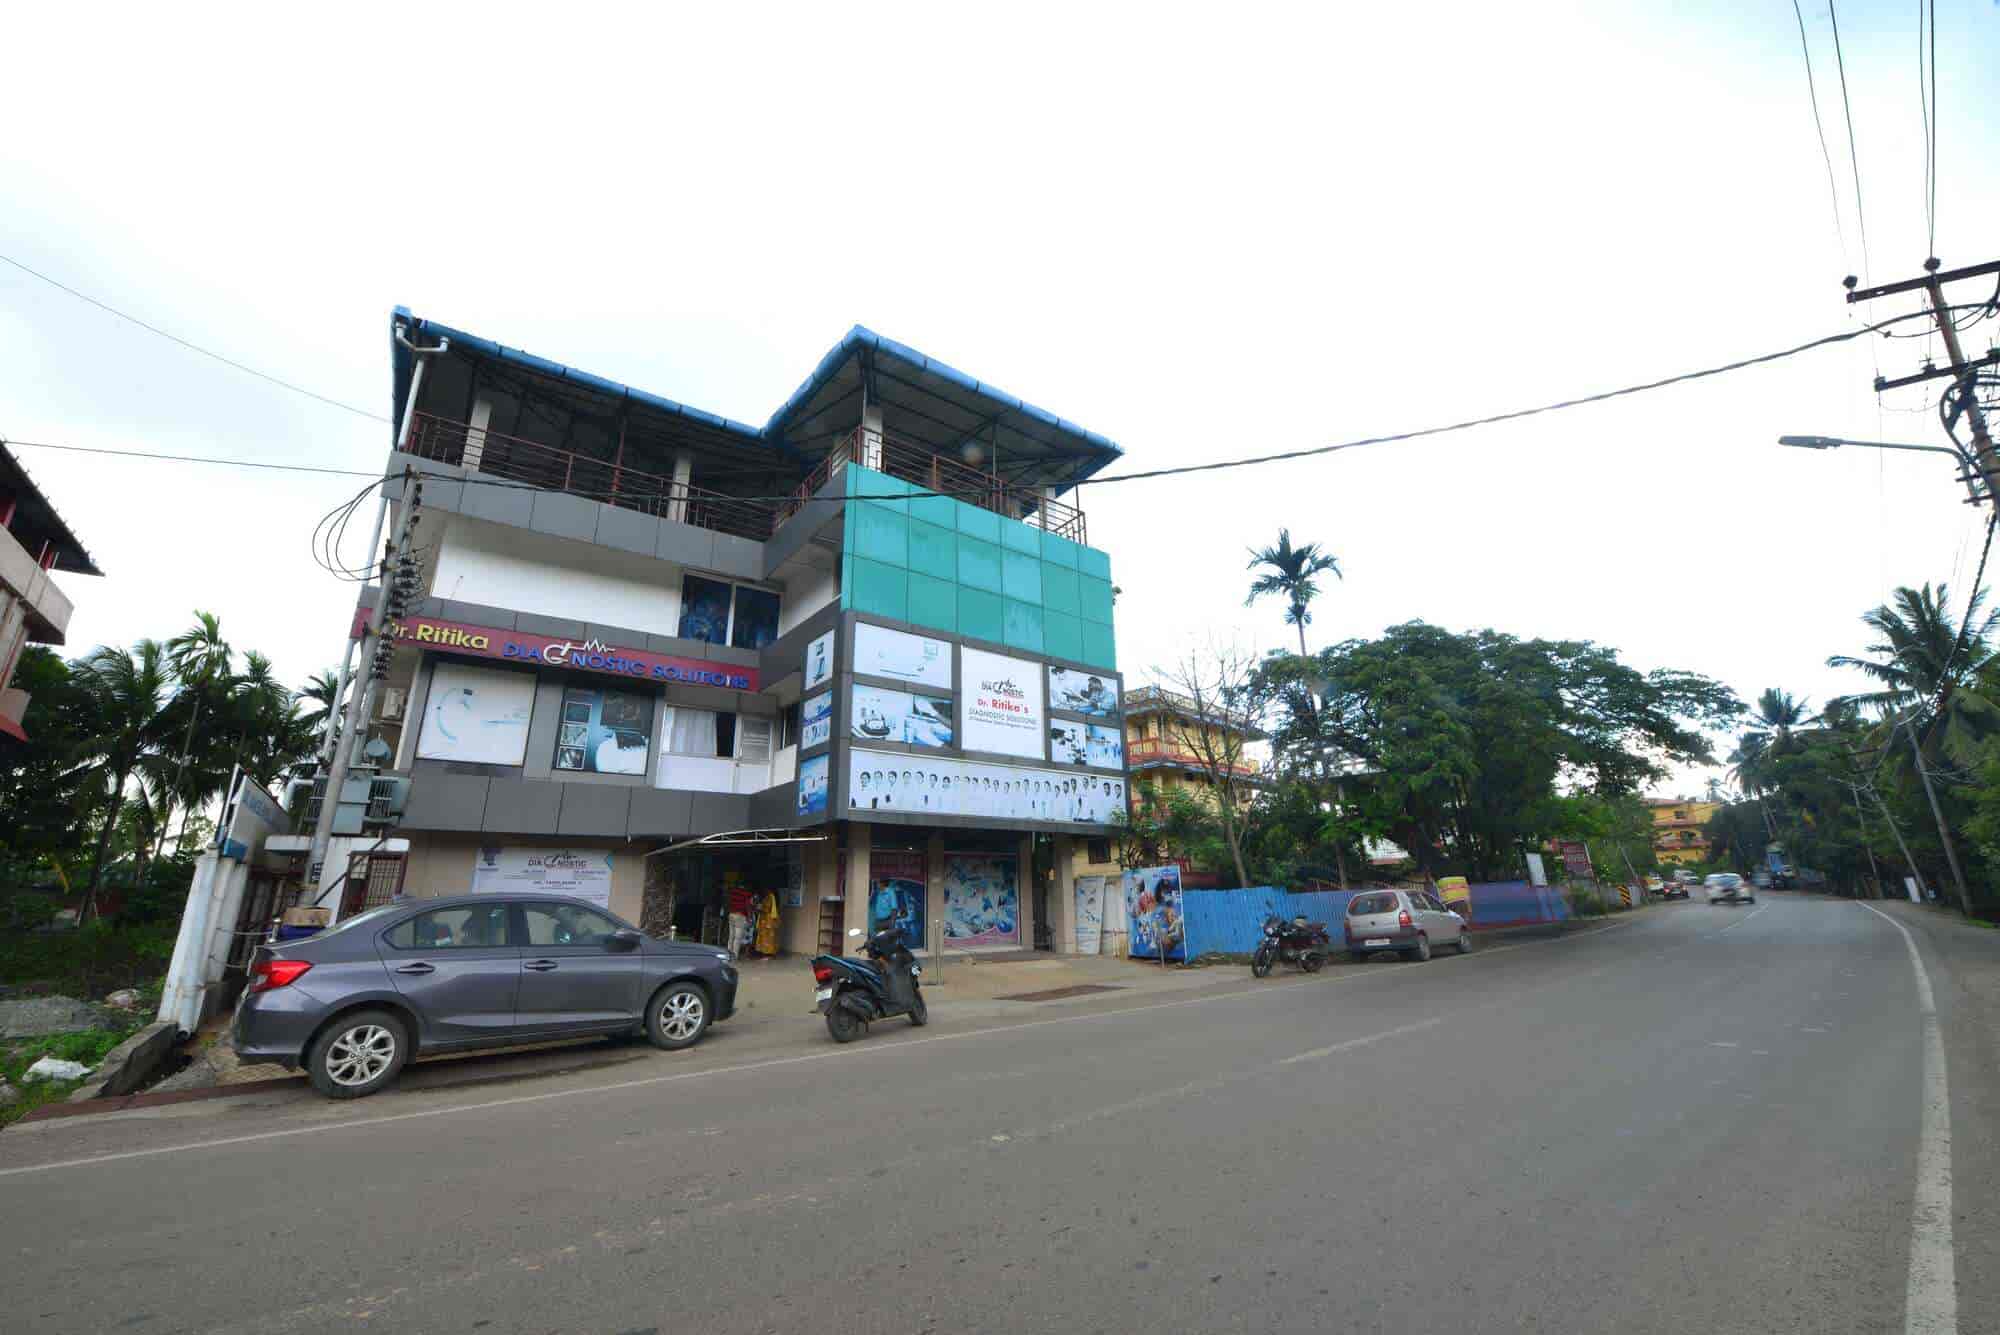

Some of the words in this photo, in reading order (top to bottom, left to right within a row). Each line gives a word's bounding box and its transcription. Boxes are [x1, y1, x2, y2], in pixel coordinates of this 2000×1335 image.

[416, 623, 489, 650] Ritika
[503, 639, 646, 675] DIAGNOSTIC
[652, 664, 749, 690] SOLUTIONS
[977, 698, 989, 707] Dr.
